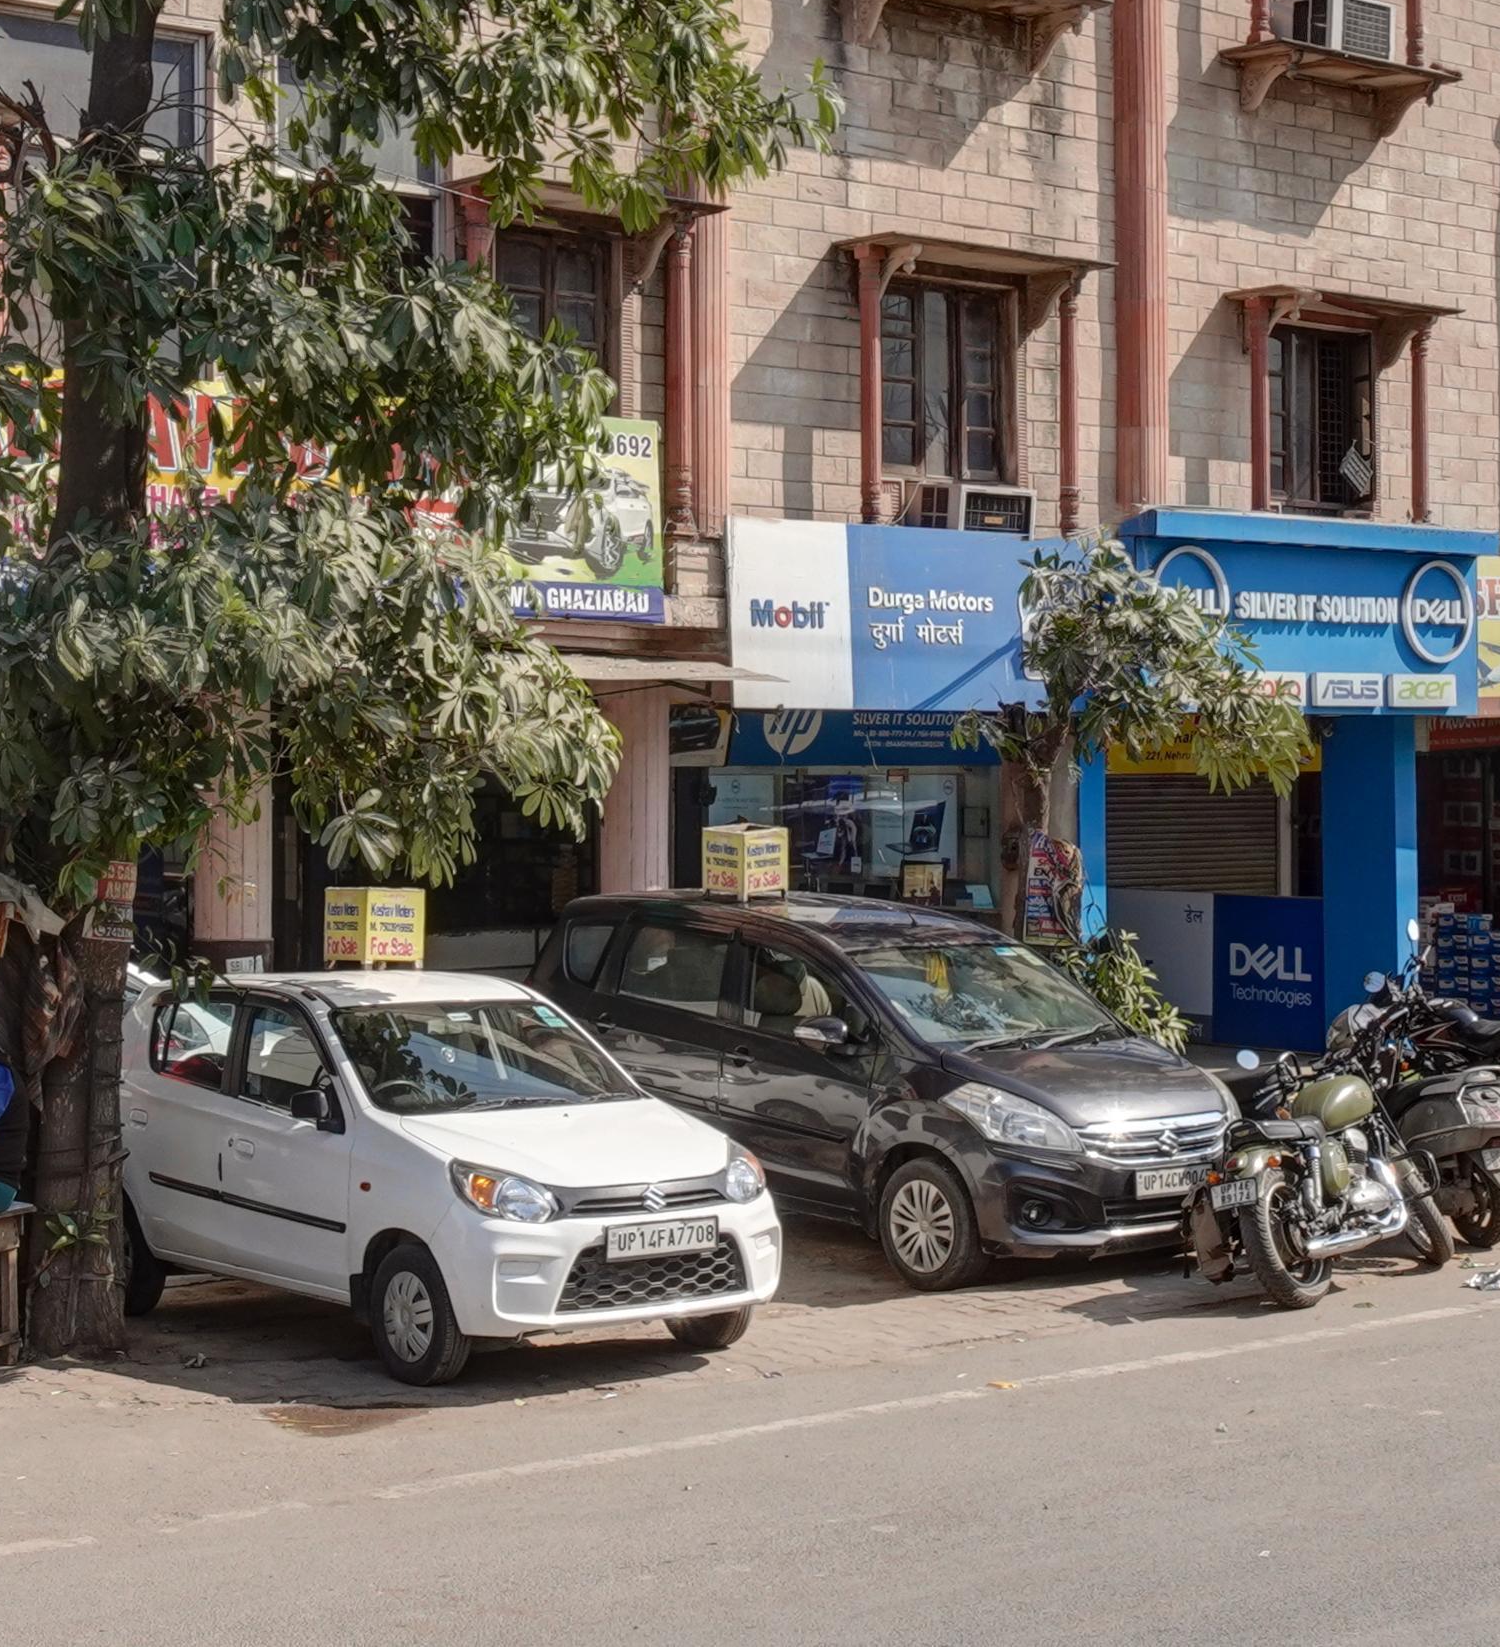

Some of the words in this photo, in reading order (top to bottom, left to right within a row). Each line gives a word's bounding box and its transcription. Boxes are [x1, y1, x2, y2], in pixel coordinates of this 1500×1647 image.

[546, 587, 650, 613] GHAZIABAD
[749, 598, 825, 629] Mobil
[867, 586, 925, 614] Durga
[929, 589, 994, 613] Motors
[1163, 586, 1222, 616] DLL
[1236, 591, 1295, 620] SILVER
[1299, 594, 1317, 620] IT
[1318, 595, 1398, 625] SOLUTION
[1415, 597, 1467, 625] DELL
[869, 617, 905, 650] दुर्गा
[915, 617, 965, 645] मोटर्स
[1321, 679, 1380, 700] ASUS
[1399, 679, 1452, 700] acer
[852, 712, 891, 726] SILVER
[891, 713, 903, 726] IT
[327, 936, 339, 955] For
[340, 936, 358, 955] Sale
[370, 936, 389, 956] For
[390, 937, 414, 957] Sale
[1229, 942, 1313, 983] DELL
[1229, 982, 1313, 1009] Technologies
[617, 1224, 715, 1252] UP14FA7708
